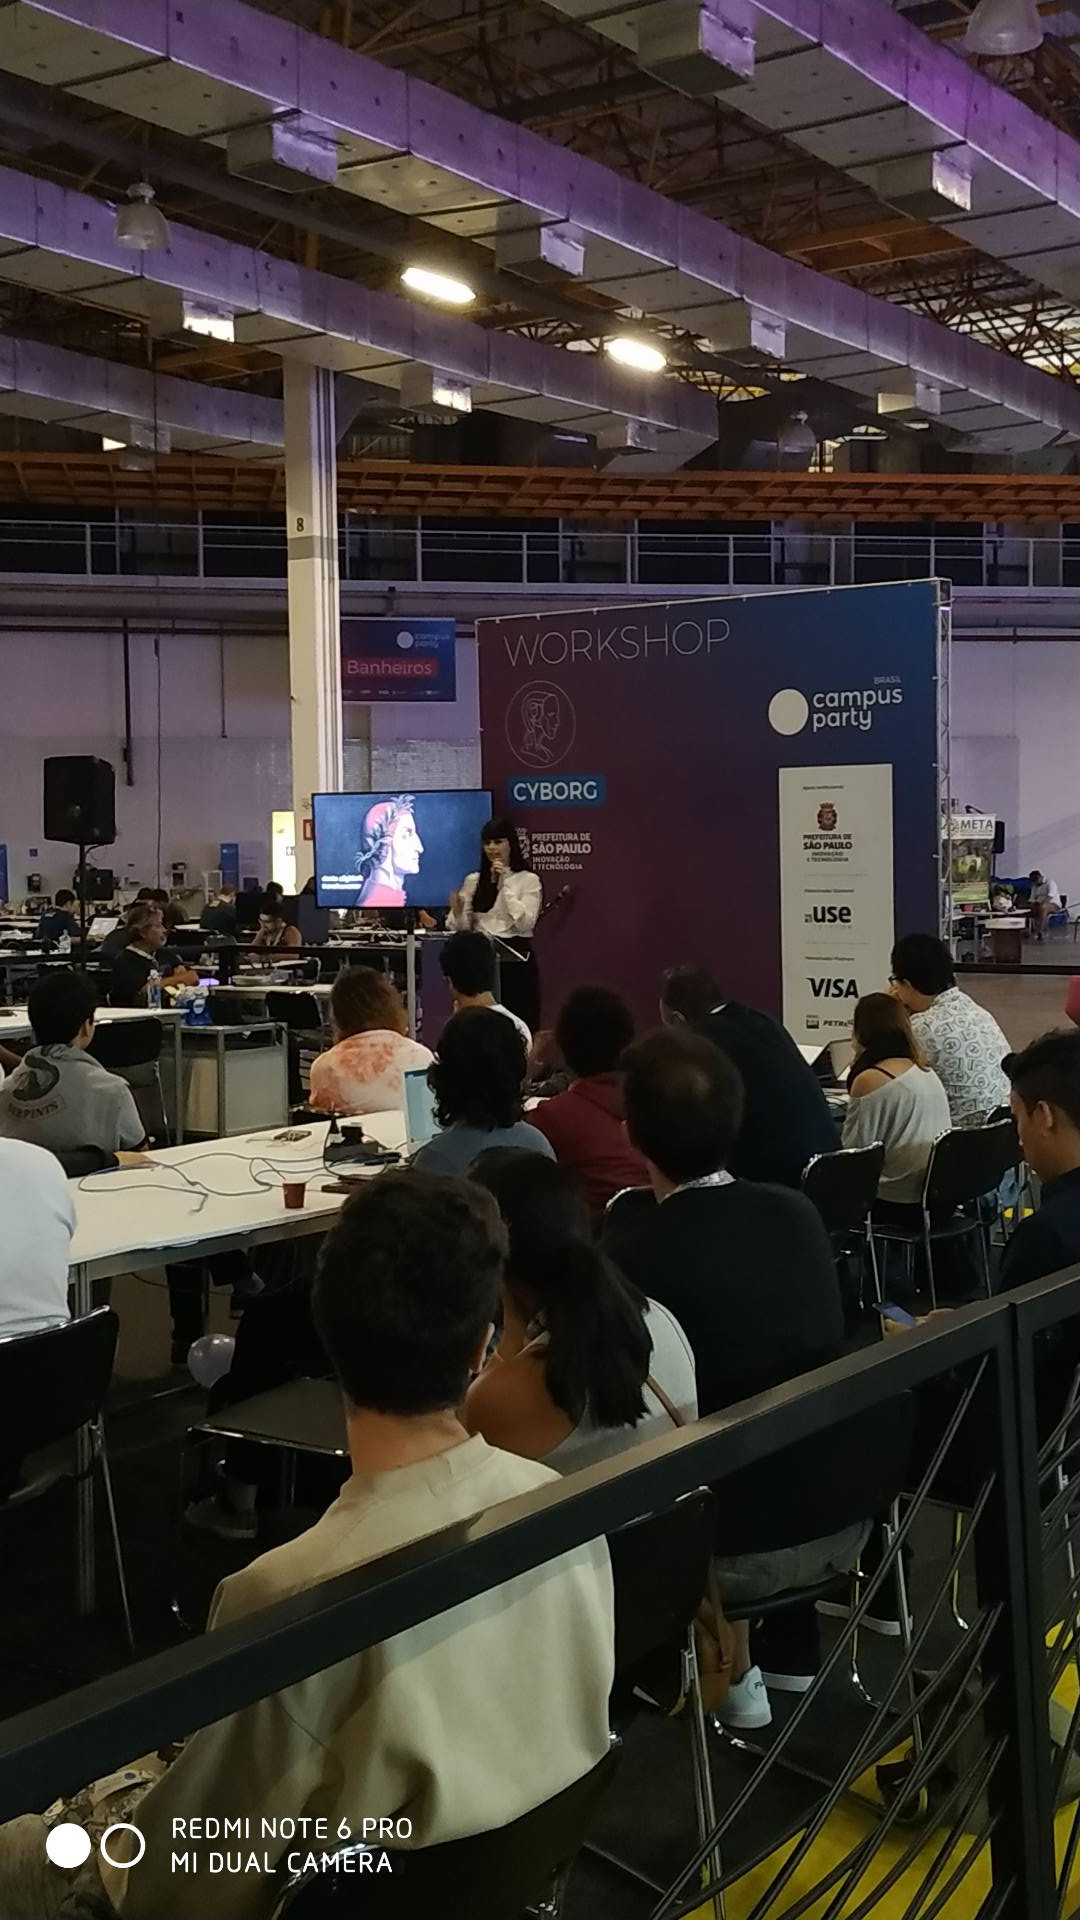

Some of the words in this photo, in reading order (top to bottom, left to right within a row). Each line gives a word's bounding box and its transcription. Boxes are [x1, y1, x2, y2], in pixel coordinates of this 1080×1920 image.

[296, 517, 304, 532] 8
[504, 618, 730, 667] WORKSHOP
[347, 660, 432, 674] Banheiros
[813, 689, 903, 710] campus
[813, 707, 872, 732] party
[513, 781, 597, 801] CYBORG
[960, 820, 993, 829] META
[532, 833, 579, 841] PREFEITURA
[580, 833, 591, 841] DE
[803, 840, 822, 850] SÃO
[823, 841, 853, 850] PAULO
[532, 842, 554, 854] SÃO
[556, 843, 591, 854] PAULO
[813, 906, 851, 923] use
[805, 978, 859, 999] VISA
